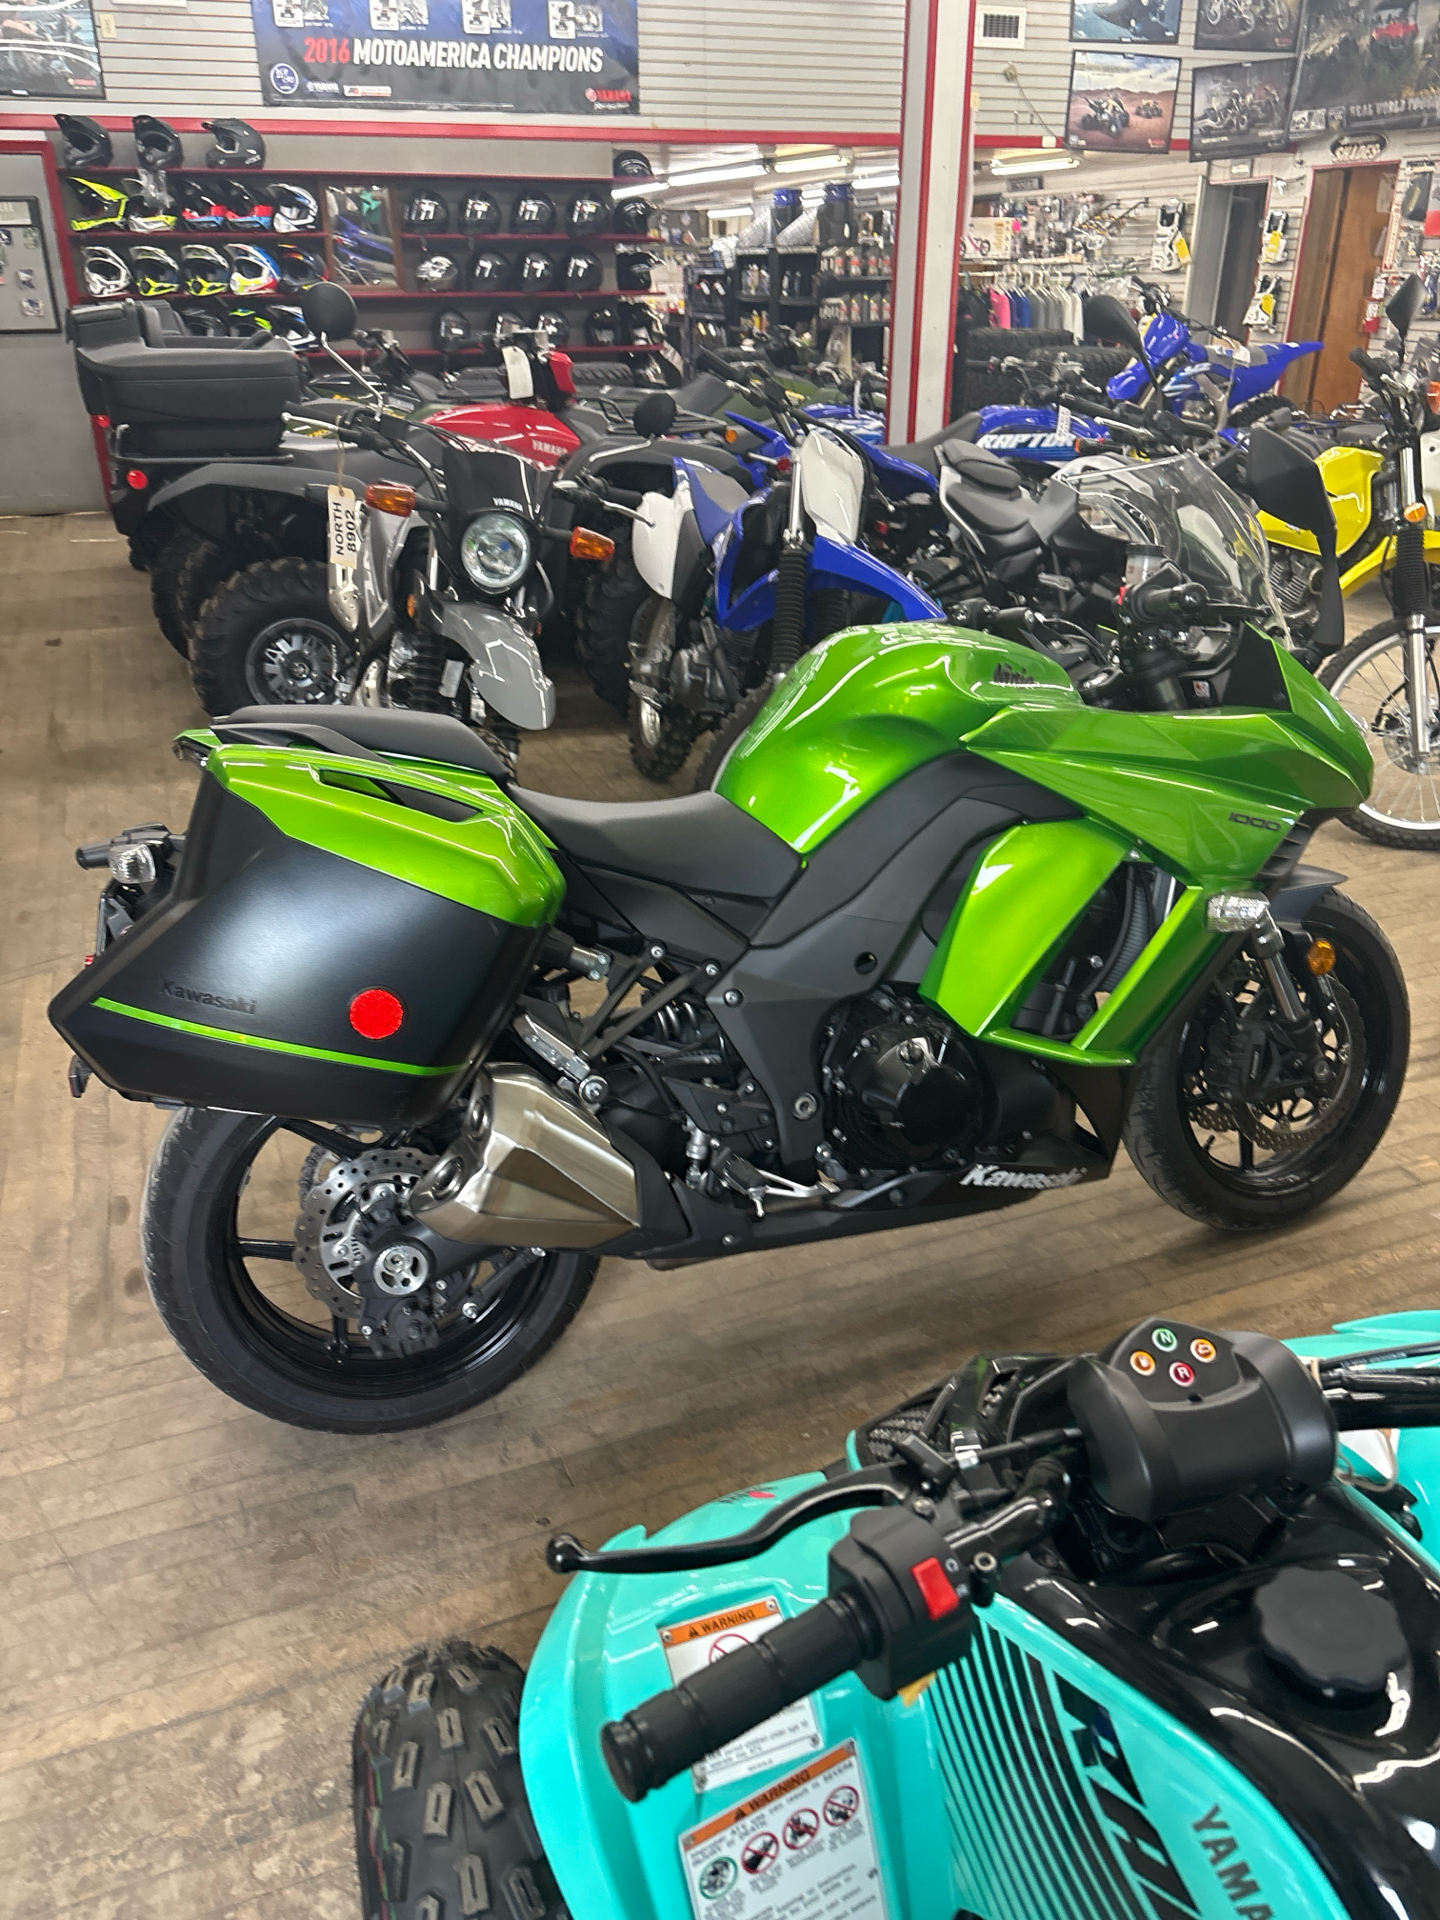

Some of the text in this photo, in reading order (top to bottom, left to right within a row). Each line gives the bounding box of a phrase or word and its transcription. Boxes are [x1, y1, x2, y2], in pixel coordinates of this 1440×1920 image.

[304, 37, 604, 73] 2016 MOTOAMERICA CHAMPIONS
[976, 431, 1077, 449] RAPTOR
[492, 497, 524, 513] YAMAHA
[332, 501, 344, 556] NORTH
[345, 509, 357, 553] 8902
[162, 979, 258, 1015] Kawasaki
[958, 1163, 1090, 1190] Kawasaki
[700, 1608, 756, 1634] WARNING
[748, 1768, 812, 1812] WARNING
[1192, 1803, 1274, 1920] YAMA
